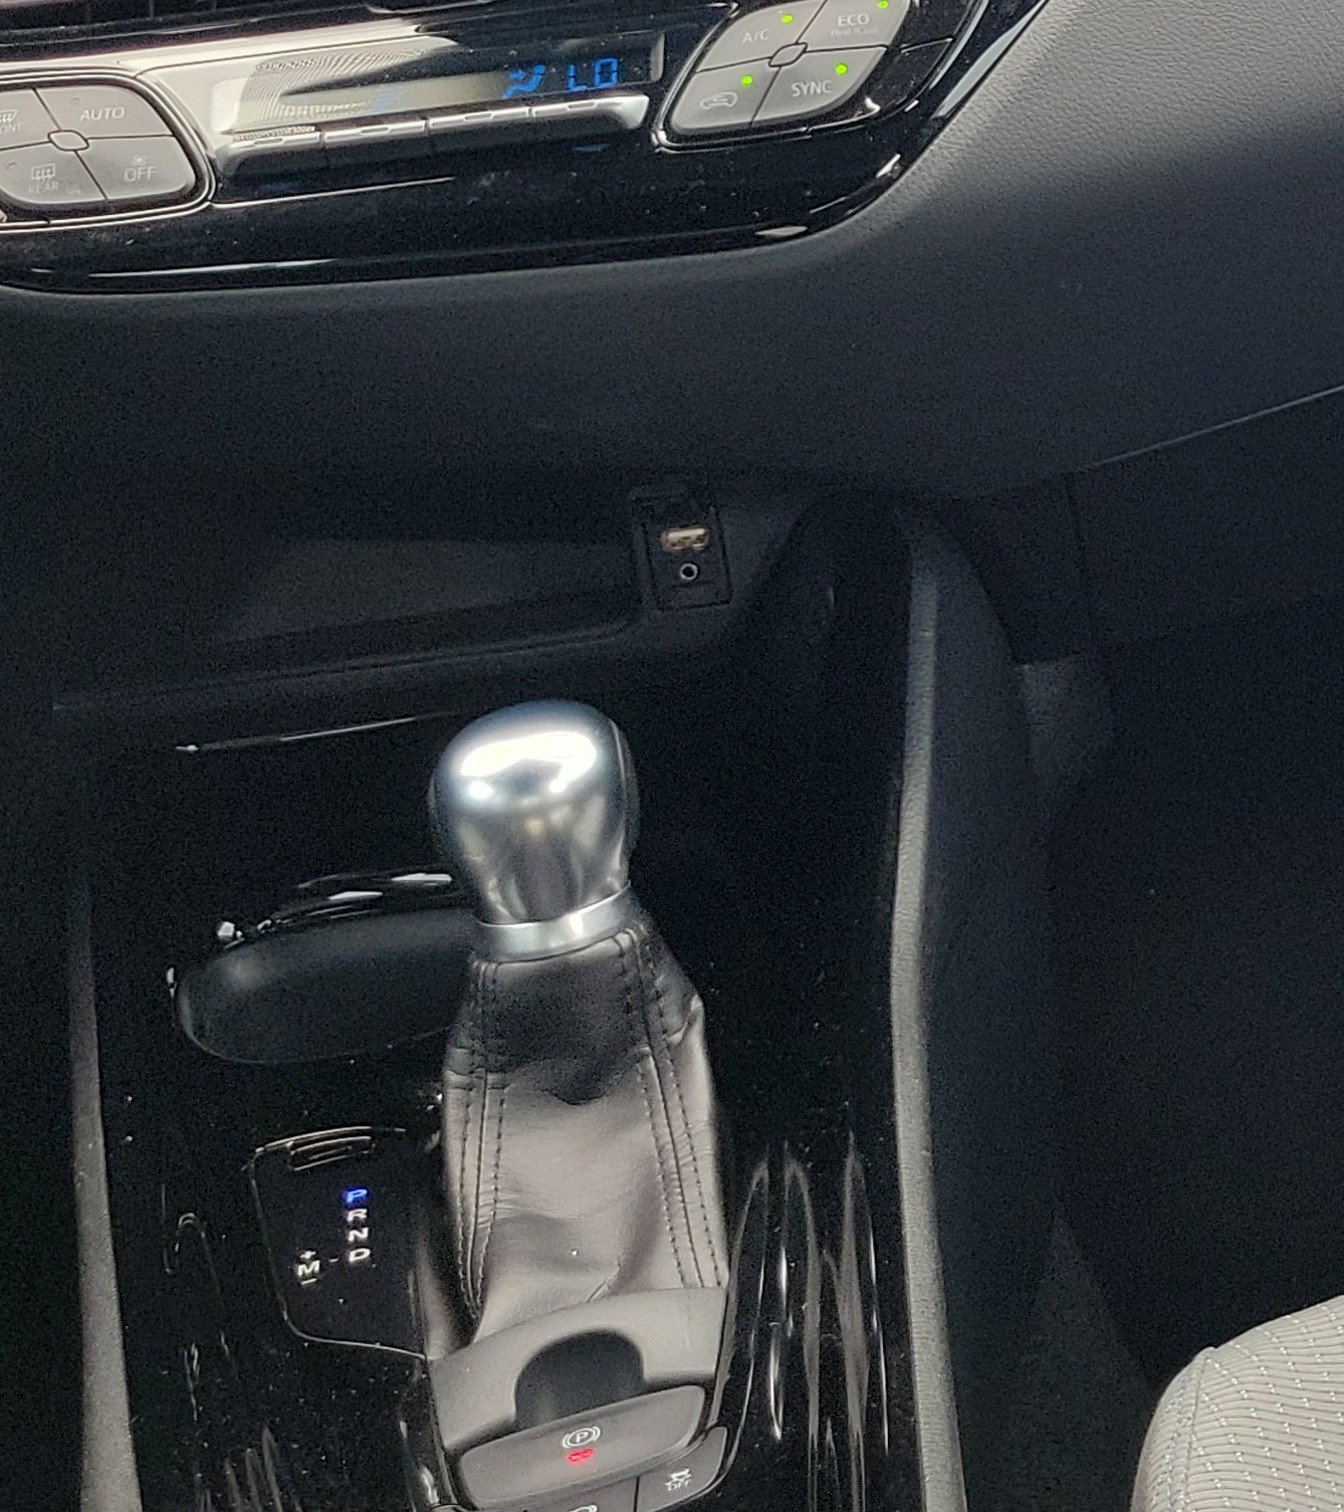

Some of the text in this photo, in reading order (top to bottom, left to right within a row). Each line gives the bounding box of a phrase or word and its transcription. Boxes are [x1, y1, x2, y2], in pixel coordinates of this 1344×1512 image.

[837, 13, 869, 27] ECO
[742, 29, 770, 44] A/C
[791, 80, 833, 97] SYNC
[80, 107, 125, 121] AUTO
[124, 166, 157, 182] OFF
[346, 1189, 367, 1203] P
[347, 1208, 368, 1222] R
[348, 1228, 369, 1242] N
[349, 1248, 370, 1262] D
